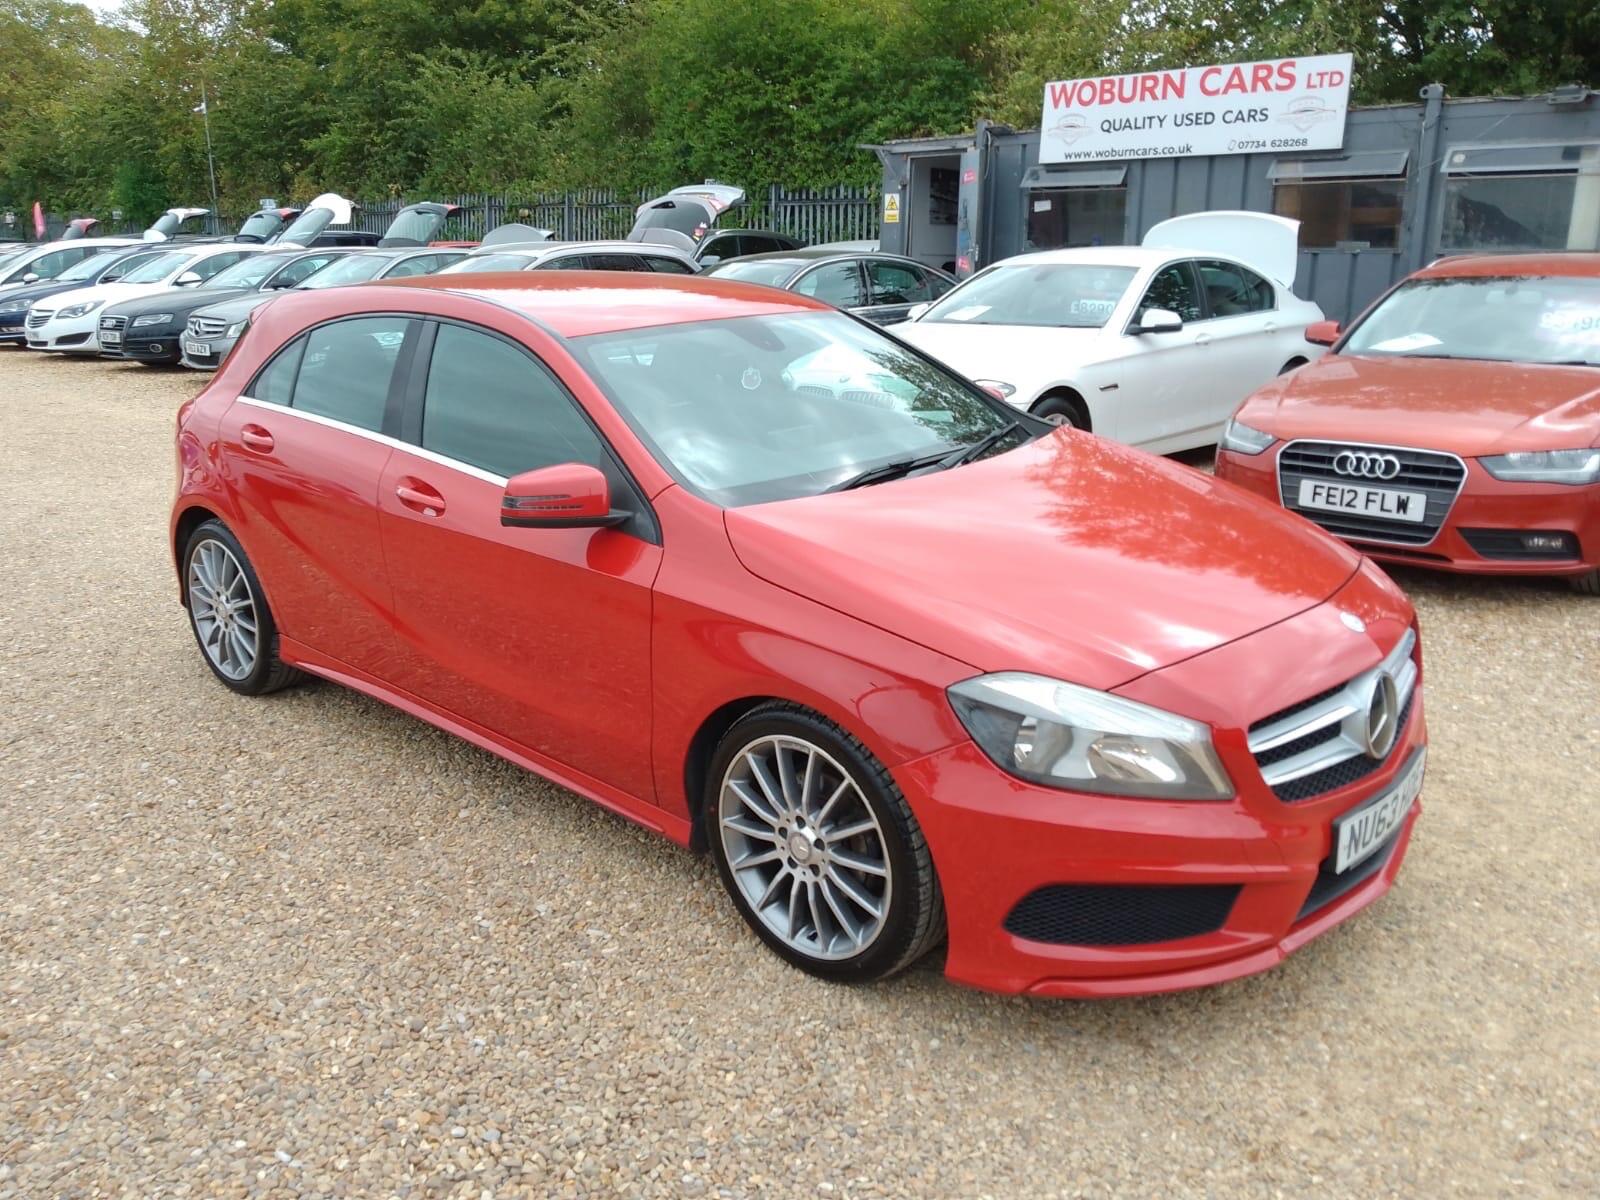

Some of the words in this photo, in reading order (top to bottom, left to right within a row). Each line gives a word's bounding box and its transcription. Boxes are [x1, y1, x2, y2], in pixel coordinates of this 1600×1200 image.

[1050, 71, 1186, 109] WOBURN
[1200, 61, 1297, 97] CARS
[1306, 71, 1344, 89] LTD
[1100, 115, 1166, 134] QUALITY
[1173, 111, 1215, 128] USED
[1222, 108, 1270, 125] CARS
[1064, 144, 1193, 160] www.woburncars.co.uk
[1238, 140, 1267, 150] 07734
[1270, 138, 1308, 148] 628268
[1311, 485, 1357, 508] FE12
[1365, 492, 1409, 515] FLW
[1347, 794, 1398, 860] NU63
